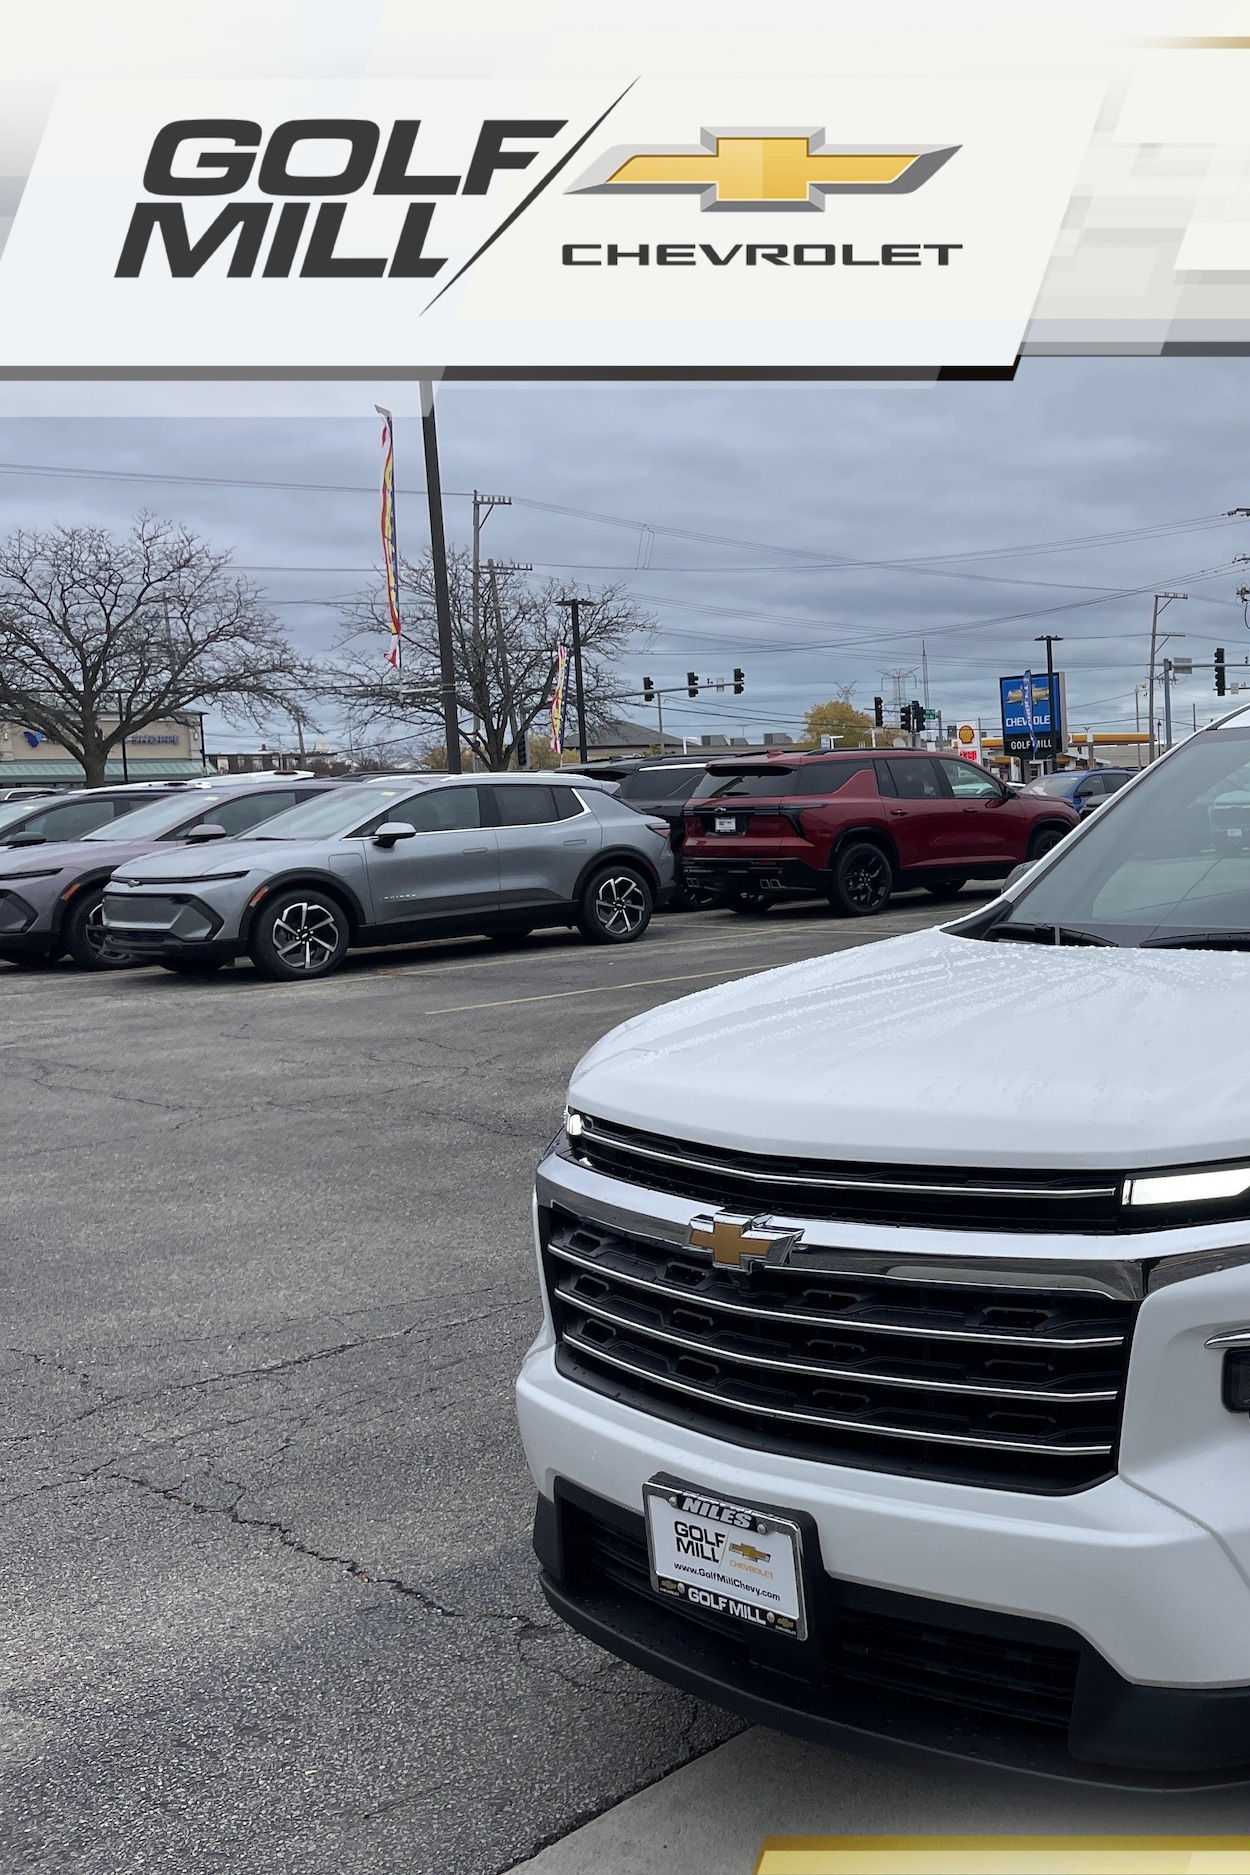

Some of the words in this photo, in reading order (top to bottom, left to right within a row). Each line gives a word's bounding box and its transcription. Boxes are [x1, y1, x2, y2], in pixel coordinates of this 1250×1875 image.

[1011, 740, 1031, 750] GOLF
[681, 1496, 752, 1528] NILES
[674, 1521, 726, 1547] GOLF
[676, 1537, 720, 1564] MILL
[674, 1562, 781, 1602] www.GolfMillChevy.com
[729, 1559, 774, 1579] CHEVROLET
[688, 1587, 727, 1611] GOLF
[728, 1600, 767, 1625] MILL
